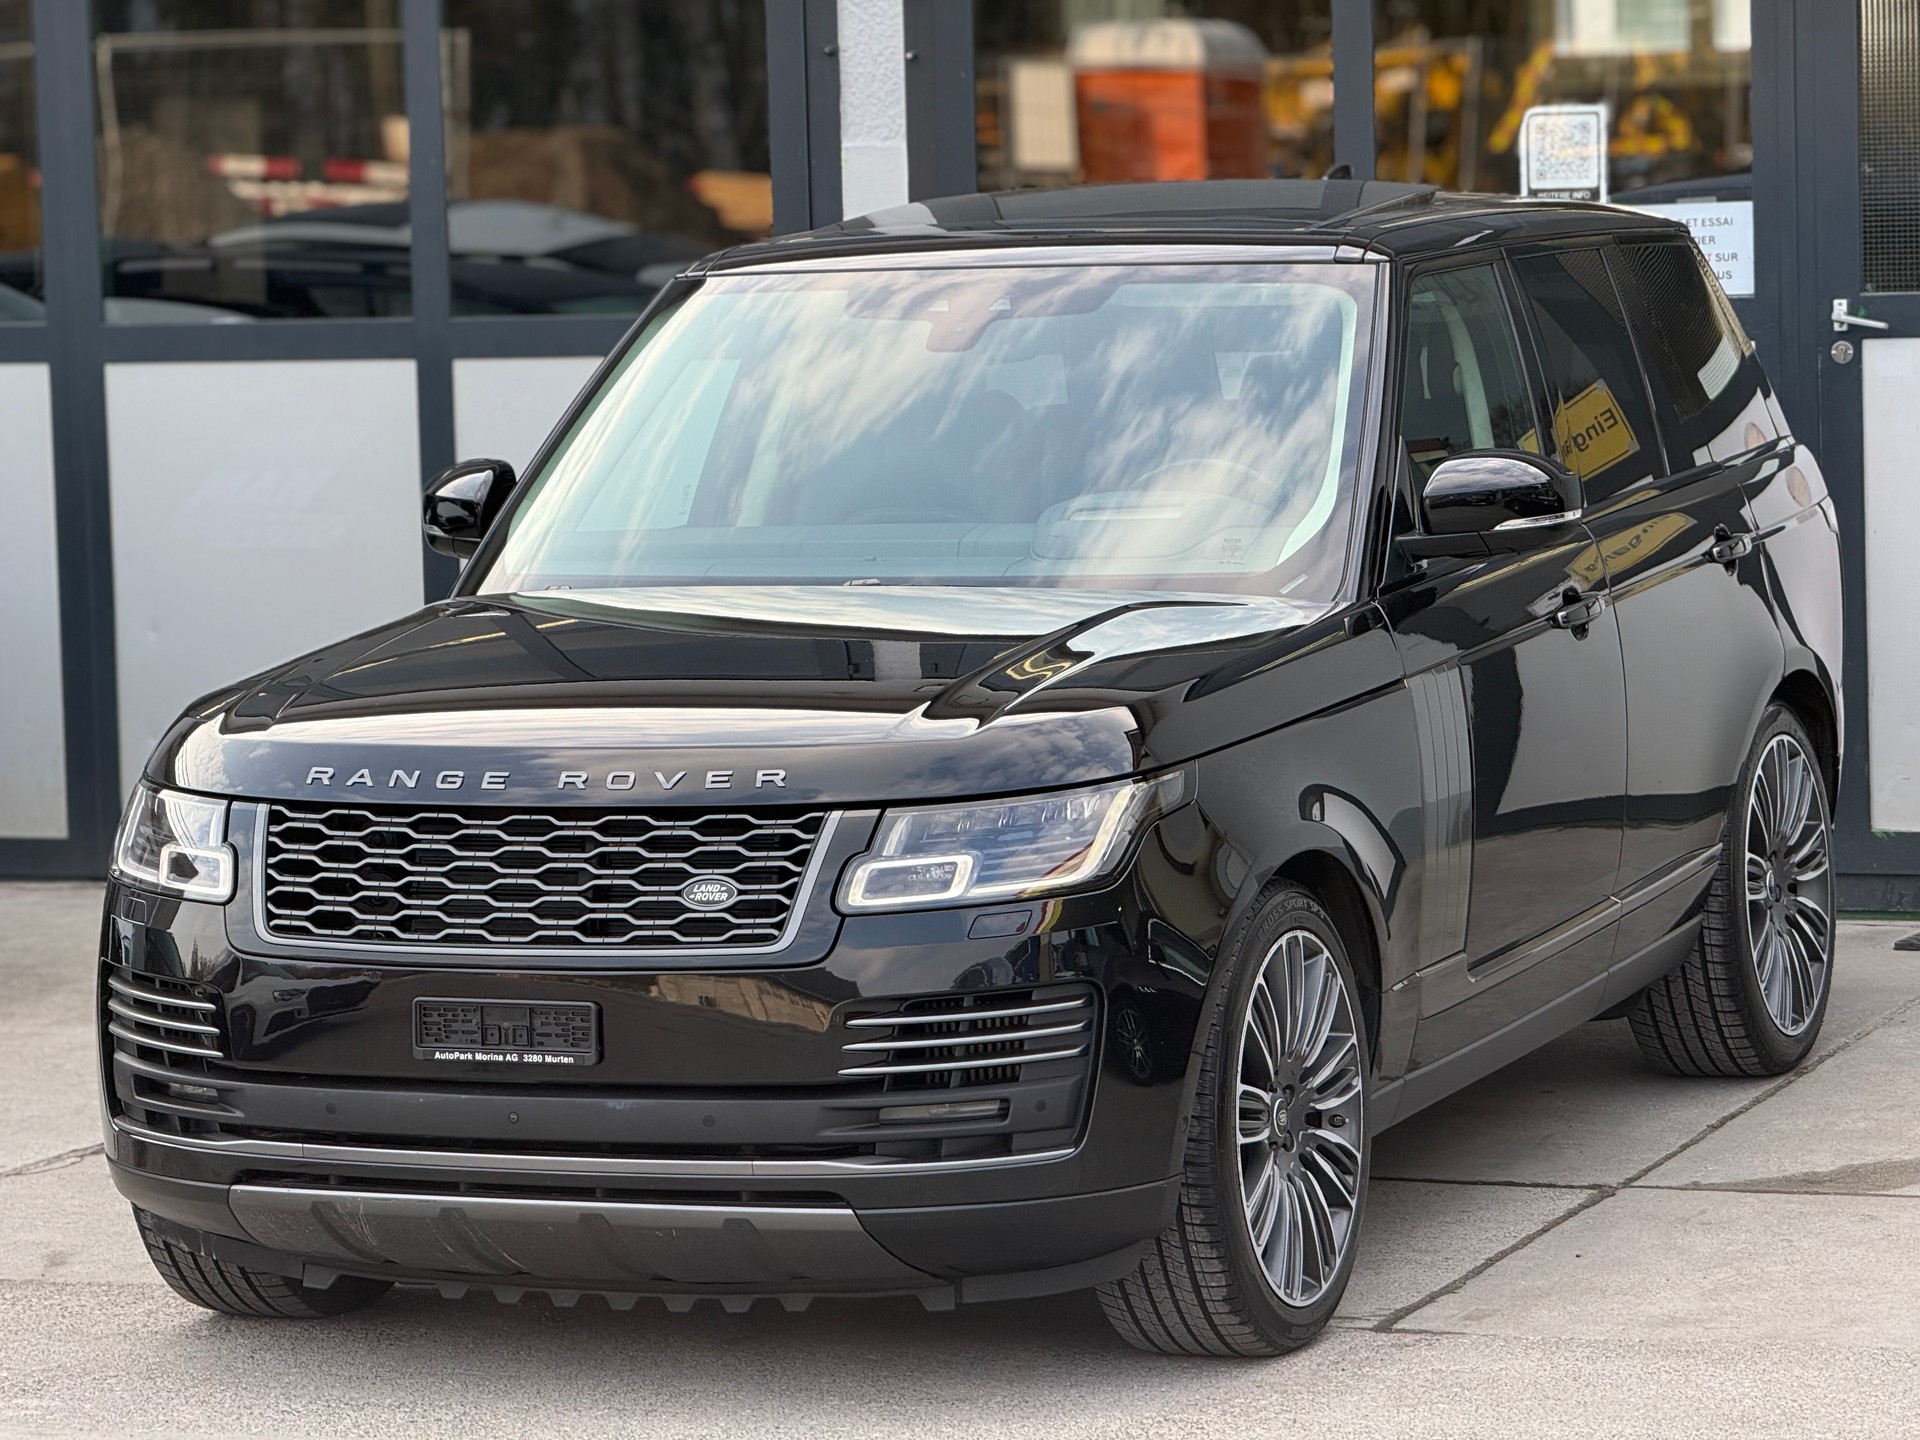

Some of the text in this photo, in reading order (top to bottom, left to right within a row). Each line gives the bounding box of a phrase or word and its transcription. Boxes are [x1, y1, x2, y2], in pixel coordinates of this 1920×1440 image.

[1701, 217, 1733, 228] ESSAI
[1715, 252, 1738, 263] SUR
[305, 766, 787, 791] RANGE ROVER
[693, 884, 720, 892] LAND
[694, 892, 728, 901] ROVER
[1284, 899, 1307, 911] SPORT
[434, 1051, 574, 1064] AutoPark Morina AG 3280 Murten
